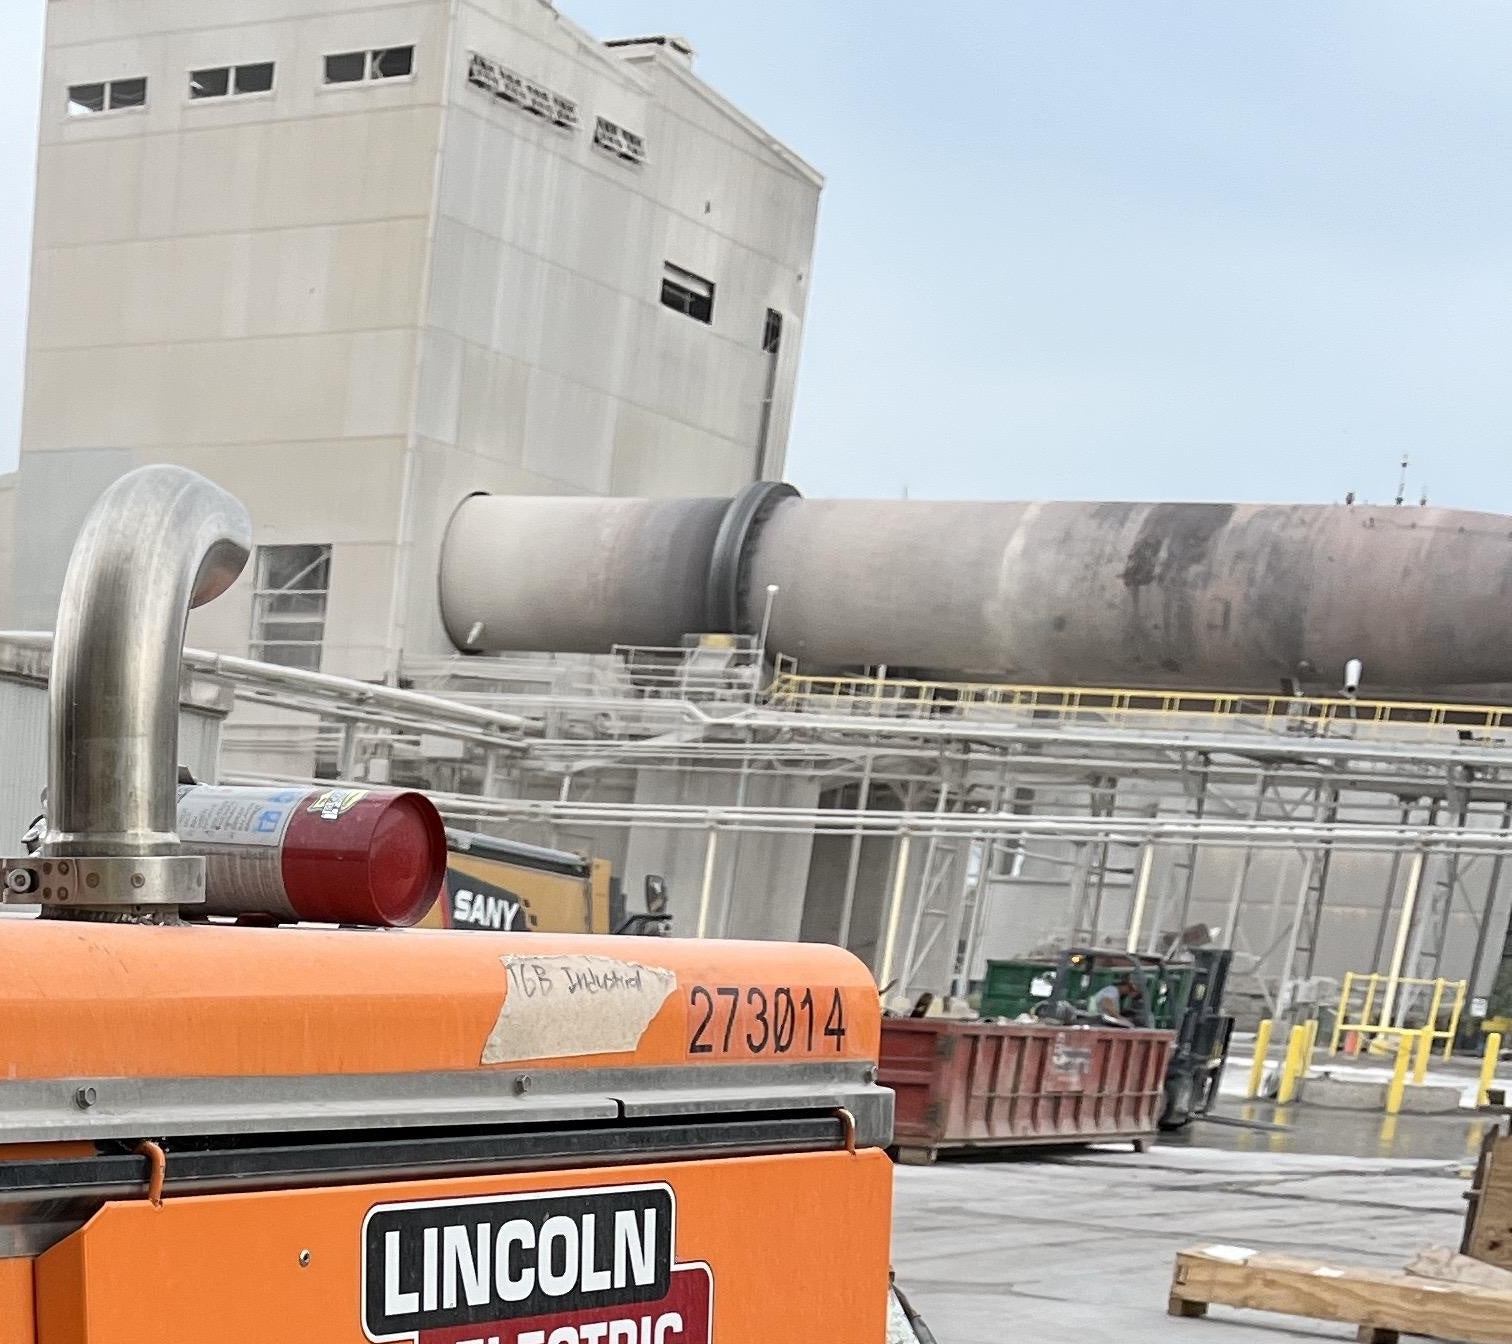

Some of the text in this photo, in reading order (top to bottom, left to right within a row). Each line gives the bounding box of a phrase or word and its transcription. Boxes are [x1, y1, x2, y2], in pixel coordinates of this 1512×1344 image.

[453, 889, 520, 931] SANY
[688, 985, 846, 1054] 273014
[384, 1207, 657, 1317] LINCOLN
